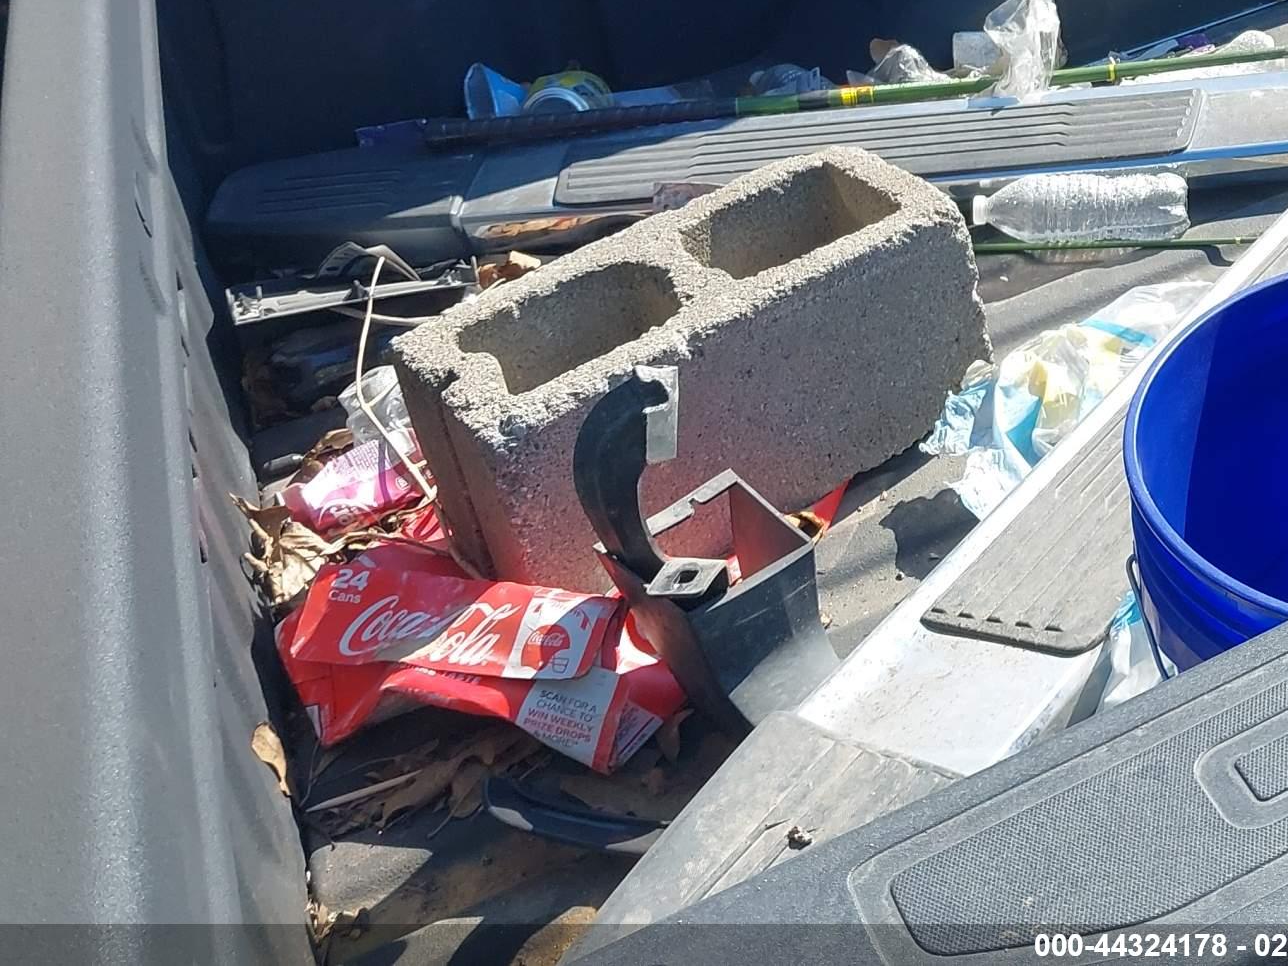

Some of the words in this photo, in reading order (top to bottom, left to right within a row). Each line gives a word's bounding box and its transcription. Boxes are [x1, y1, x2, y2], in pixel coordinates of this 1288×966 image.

[331, 568, 370, 591] 24
[328, 590, 362, 604] Cans
[536, 699, 576, 717] CHANCE
[578, 712, 594, 724] TO
[540, 690, 568, 705] SCAN
[569, 697, 588, 711] FOR
[588, 704, 598, 714] A
[523, 718, 554, 733] PRIZE
[555, 726, 592, 743] DROPS
[528, 708, 549, 720] WIN
[550, 713, 595, 733] WEEKLY
